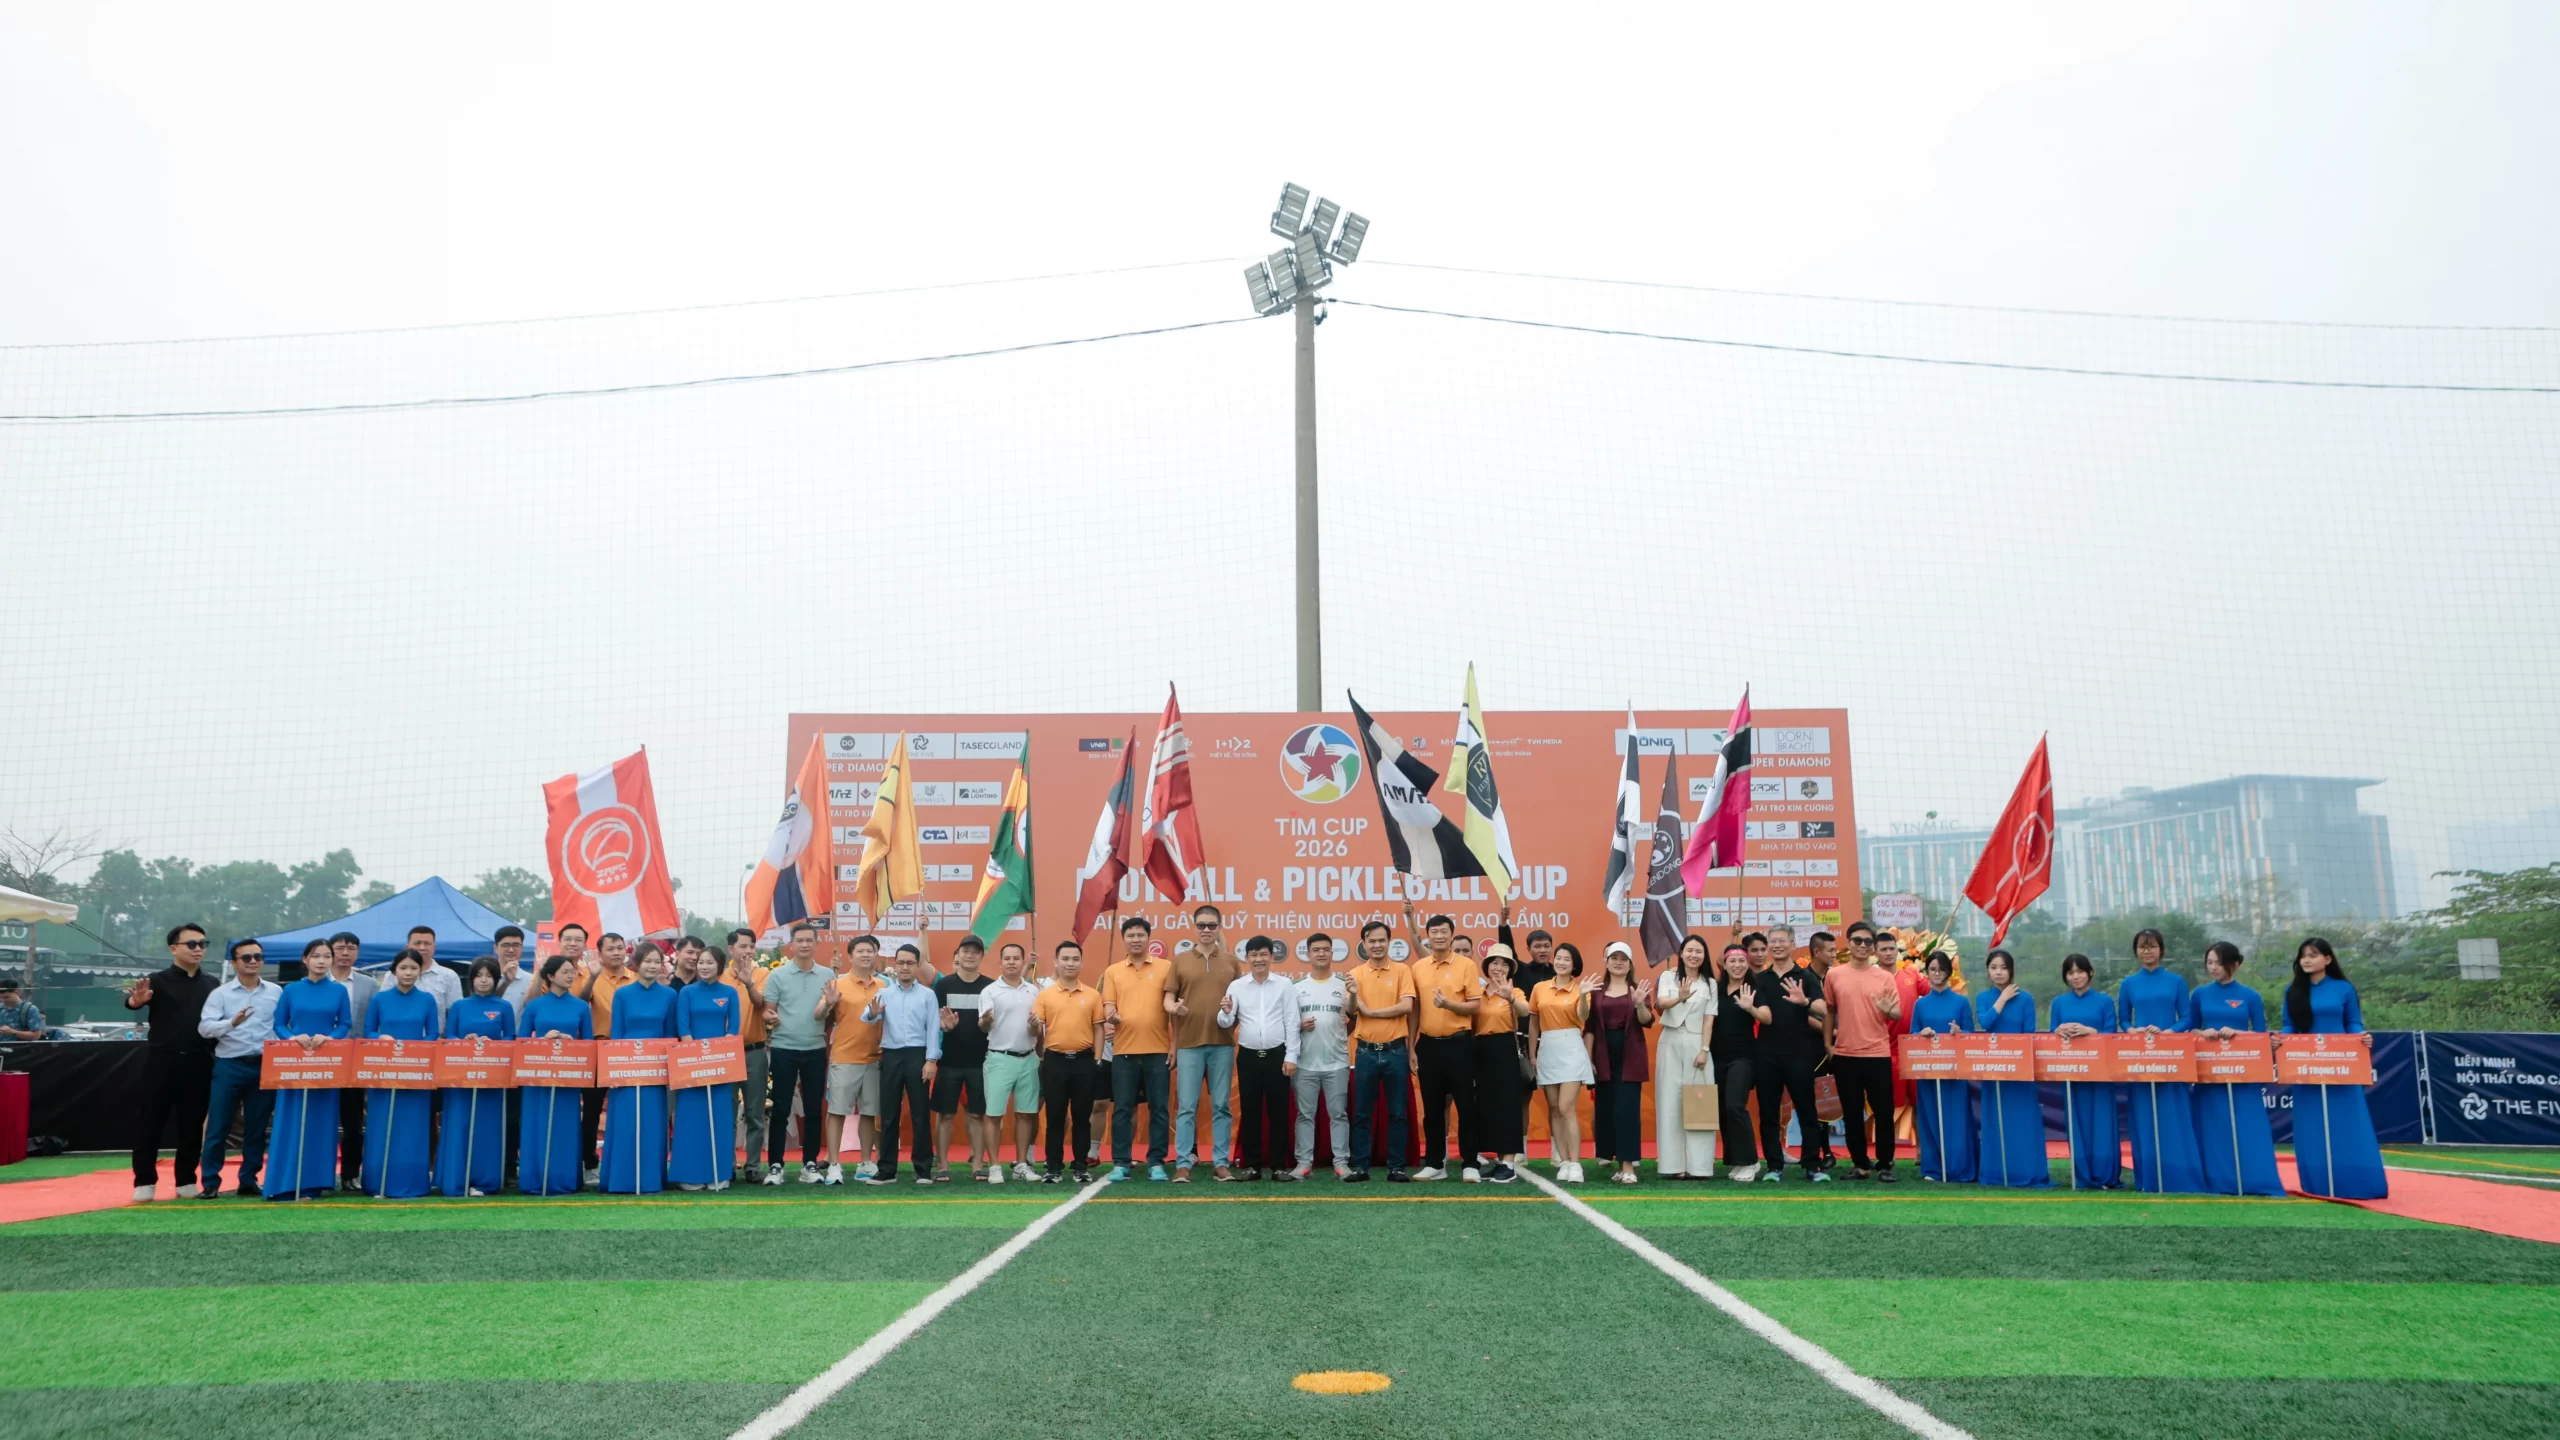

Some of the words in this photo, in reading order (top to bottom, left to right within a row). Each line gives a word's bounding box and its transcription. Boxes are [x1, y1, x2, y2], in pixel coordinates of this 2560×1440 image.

[1777, 732, 1811, 742] DORN
[1778, 742, 1811, 750] BRACHT
[826, 763, 844, 772] PER
[848, 763, 888, 772] DIAMO
[1752, 758, 1774, 768] UPER
[1778, 757, 1831, 767] DIAMOND
[1788, 804, 1802, 812] KIM
[1274, 818, 1316, 836] TIM
[1323, 818, 1368, 836] CUP
[1295, 840, 1348, 857] 2026
[1648, 858, 1682, 888] ENDONG
[1076, 866, 1243, 902] OTALL
[1254, 878, 1271, 901] &
[1283, 866, 1488, 901] PICKLEBALL
[1506, 866, 1568, 900] CUP
[1223, 910, 1248, 929] UỸ
[1254, 910, 1311, 933] THIỆN
[1462, 913, 1499, 928] CAO
[1511, 906, 1545, 928] LẦN
[1549, 912, 1569, 928] 10
[2455, 1054, 2481, 1067] LIÊN
[2483, 1058, 2515, 1068] MINH
[659, 1069, 667, 1077] FC
[2008, 1064, 2016, 1072] FC
[2235, 1066, 2245, 1074] FC
[280, 1072, 300, 1080] ZONE
[2456, 1071, 2480, 1086] NỘI
[2482, 1070, 2513, 1084] THẤT
[2517, 1075, 2545, 1085] CAO
[2492, 1099, 2533, 1115] THE
